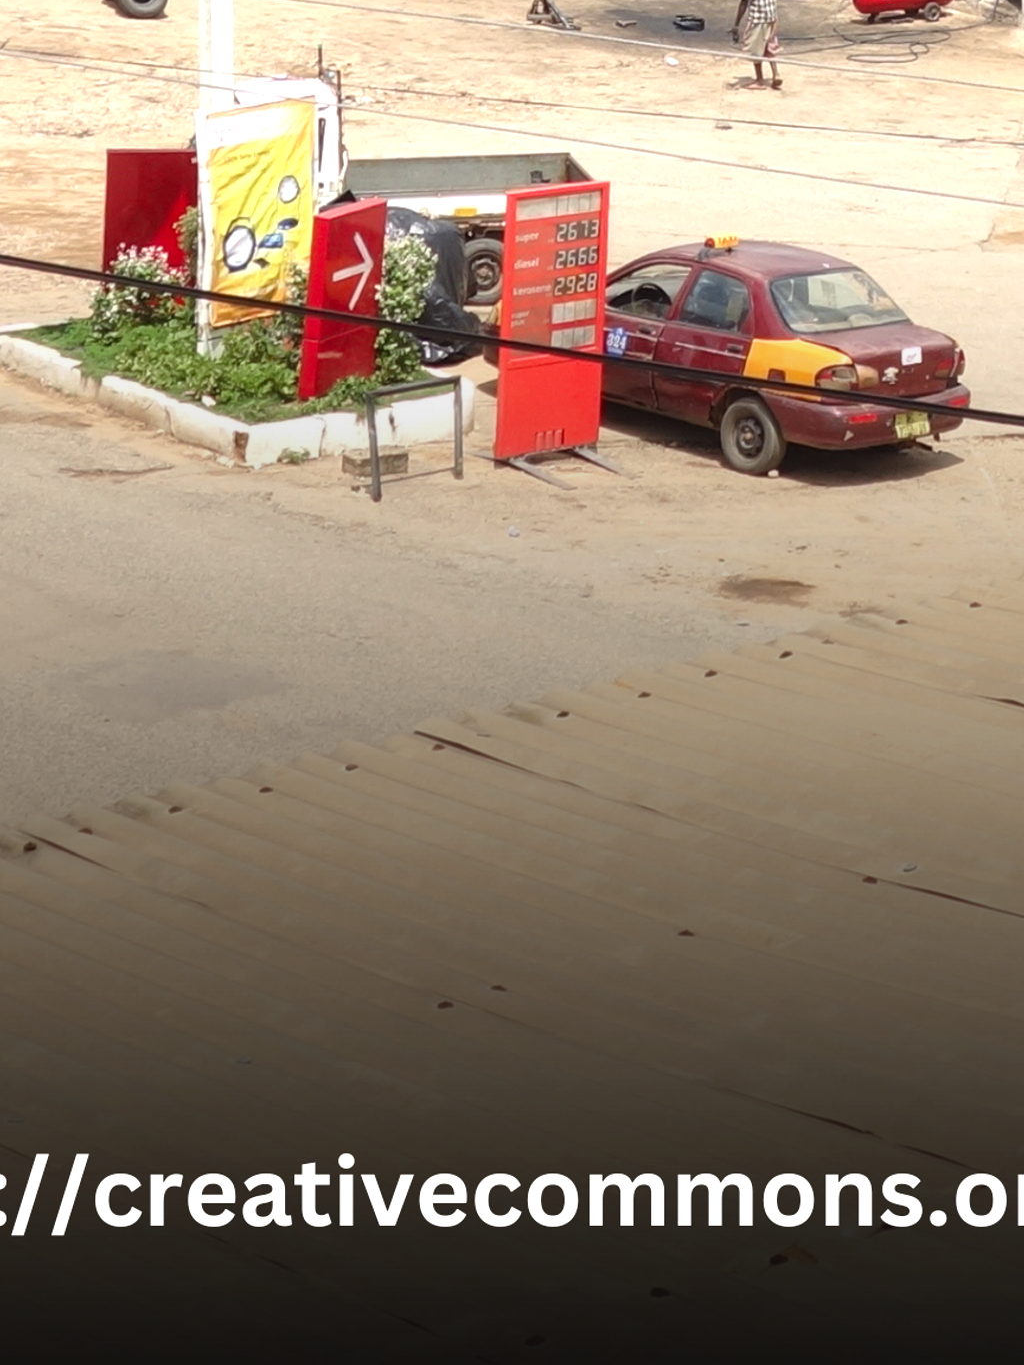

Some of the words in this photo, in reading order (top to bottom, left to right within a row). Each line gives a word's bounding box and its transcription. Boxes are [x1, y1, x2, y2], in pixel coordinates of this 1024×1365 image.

[515, 232, 539, 243] super
[556, 219, 599, 242] 2673
[514, 257, 539, 269] diesel
[555, 246, 598, 269] 2666
[513, 284, 552, 296] kerosene
[554, 273, 598, 296] 2928
[606, 333, 627, 349] 324
